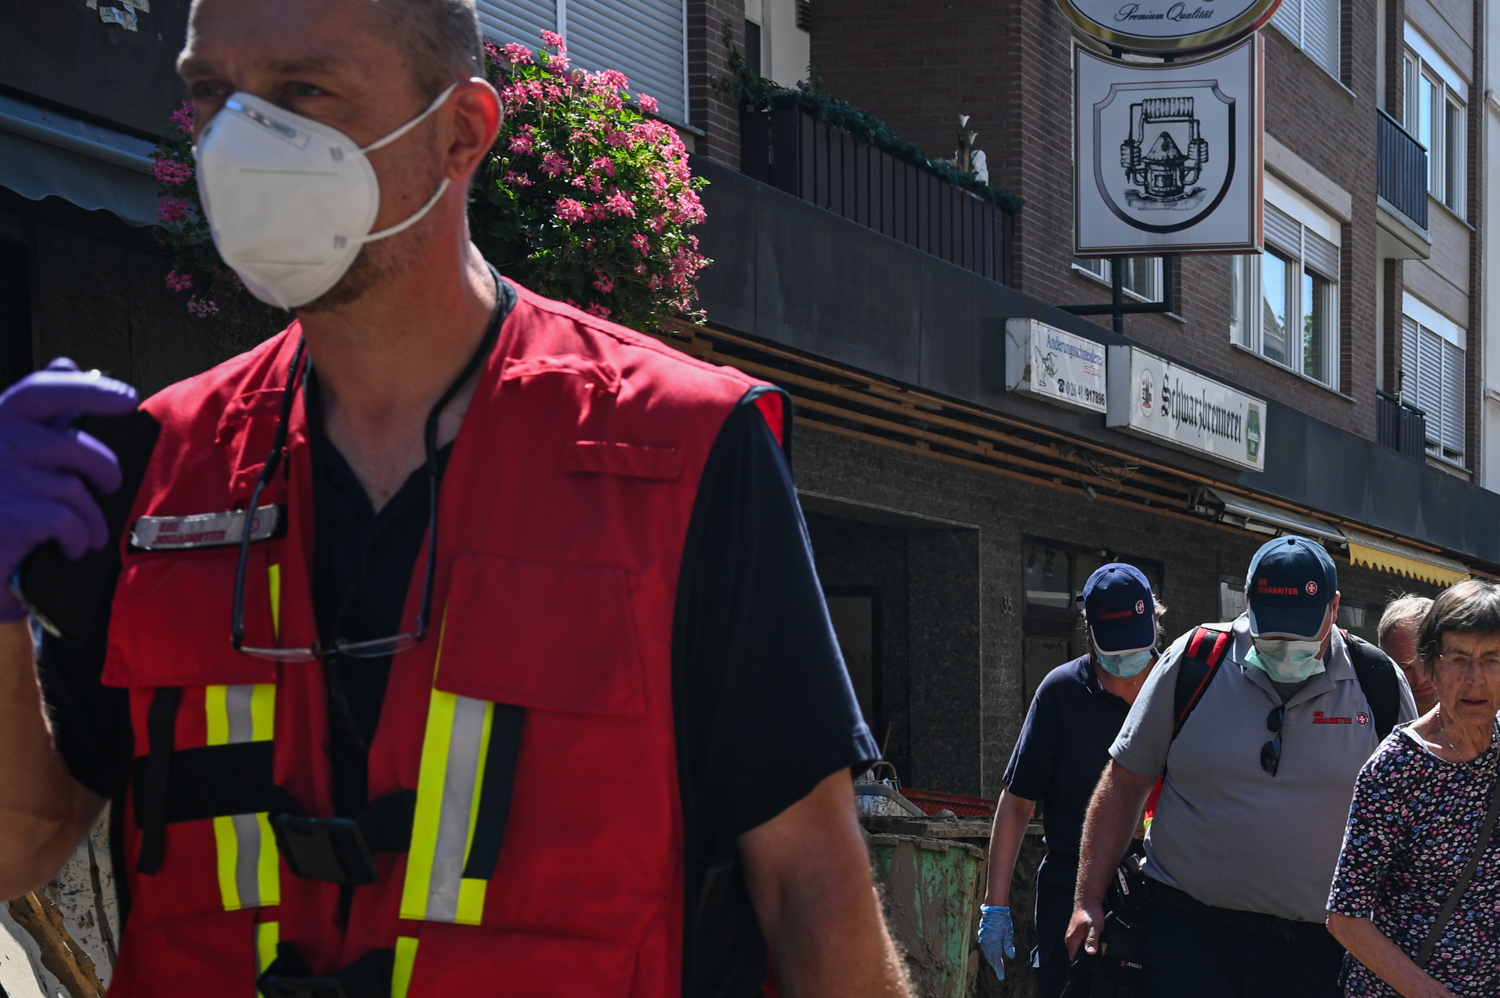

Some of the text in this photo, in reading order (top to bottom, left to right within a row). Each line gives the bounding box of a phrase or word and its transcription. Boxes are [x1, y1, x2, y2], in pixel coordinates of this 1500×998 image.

[1114, 2, 1214, 22] Premium Qualität
[1161, 373, 1242, 443] Schwarzbrennerei
[1257, 586, 1298, 595] JOHANNITER
